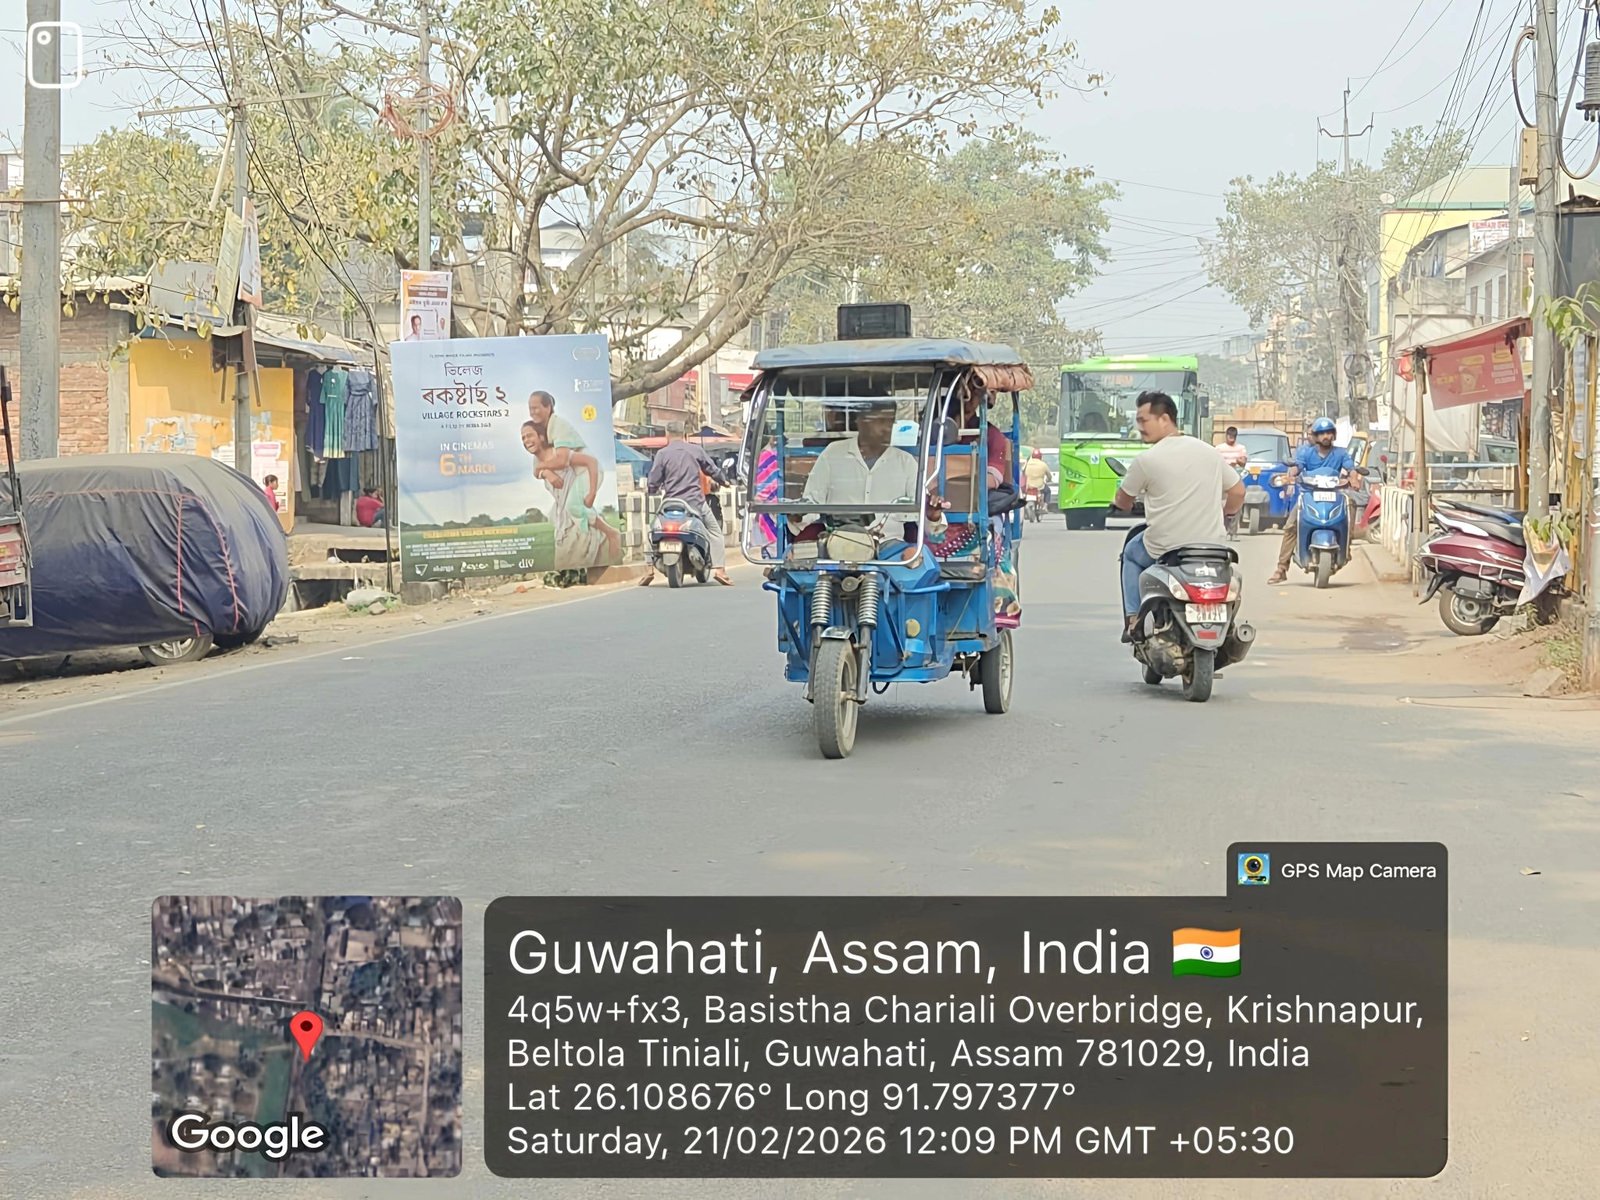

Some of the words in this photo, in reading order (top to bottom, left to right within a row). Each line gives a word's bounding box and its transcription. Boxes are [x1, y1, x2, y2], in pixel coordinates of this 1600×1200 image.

[444, 361, 484, 377] ভিলেজ
[495, 386, 509, 405] ২
[421, 411, 454, 420] VILLAGE
[456, 409, 503, 419] ROCKSTARS
[504, 409, 510, 417] 2
[440, 442, 450, 452] IN
[452, 440, 495, 451] CINEMAS
[439, 453, 457, 477] 6
[457, 463, 497, 475] MARCH
